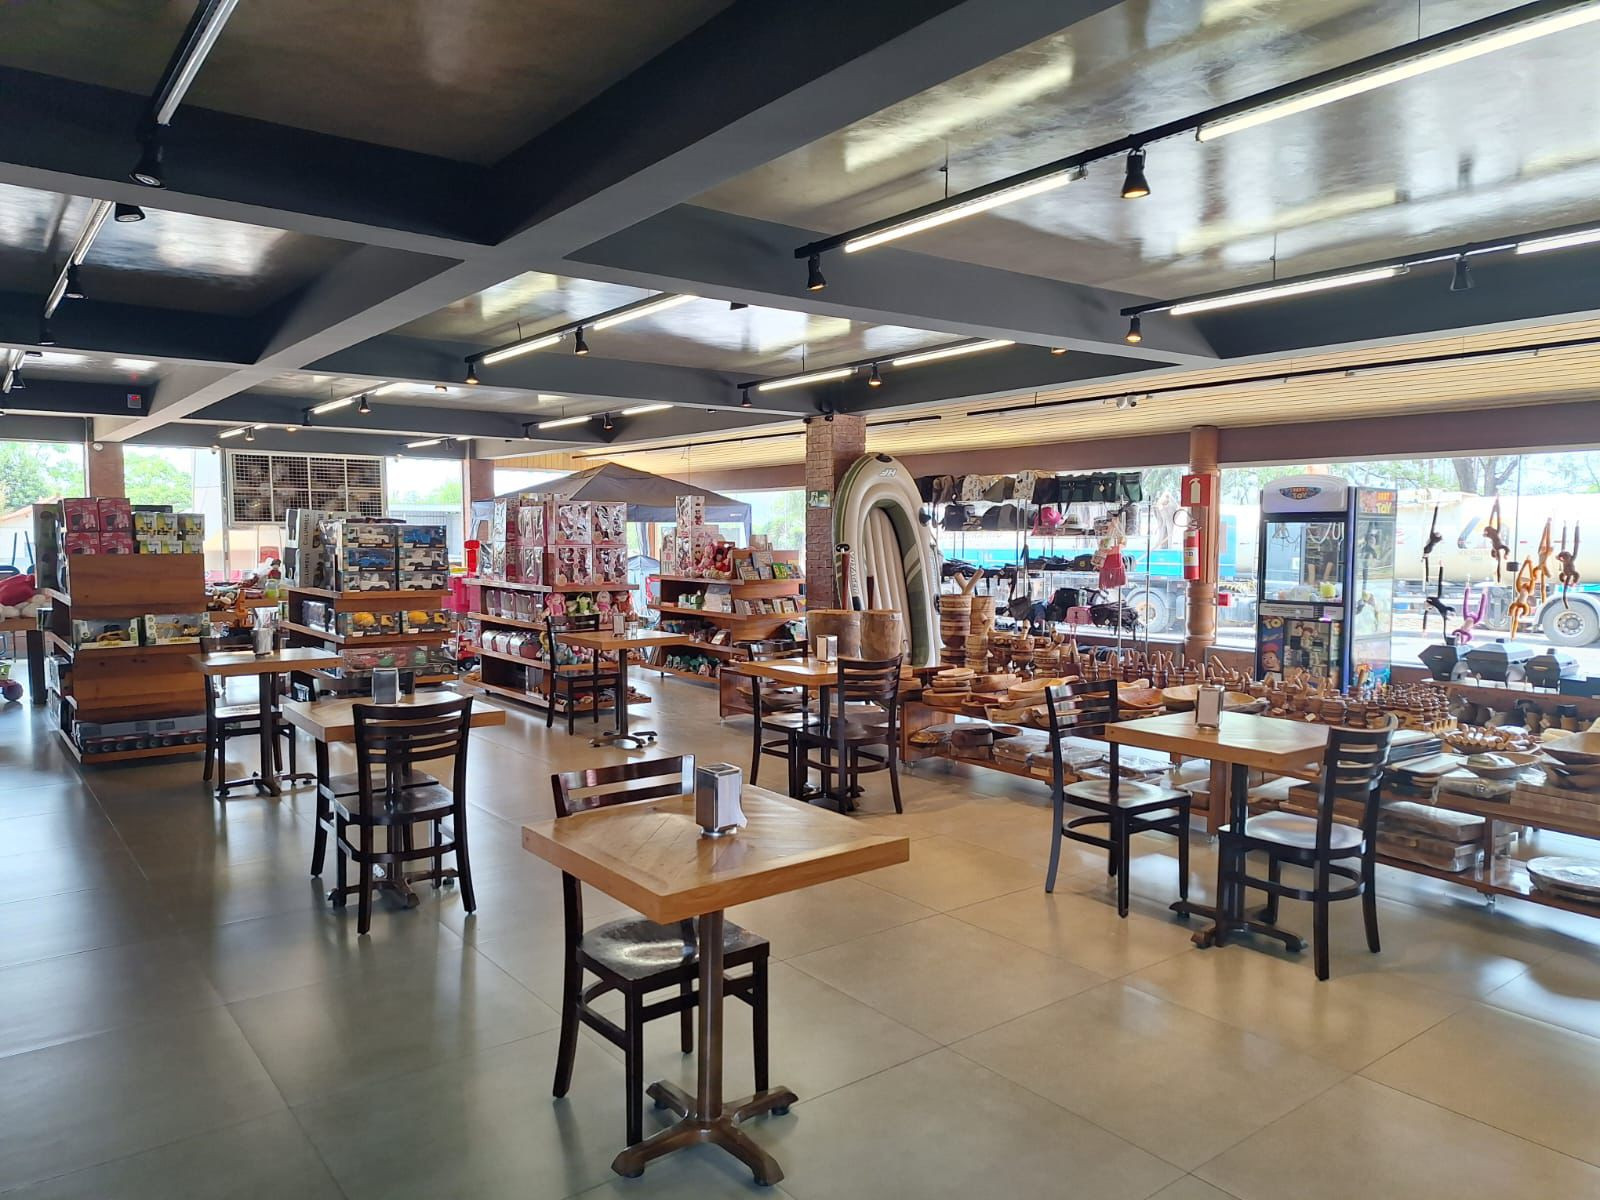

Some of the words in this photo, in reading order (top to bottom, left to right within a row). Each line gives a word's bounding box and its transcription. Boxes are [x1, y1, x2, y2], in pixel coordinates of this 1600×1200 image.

[1292, 491, 1308, 499] TOY
[1375, 502, 1392, 514] TOY
[850, 551, 859, 593] VOYAGER
